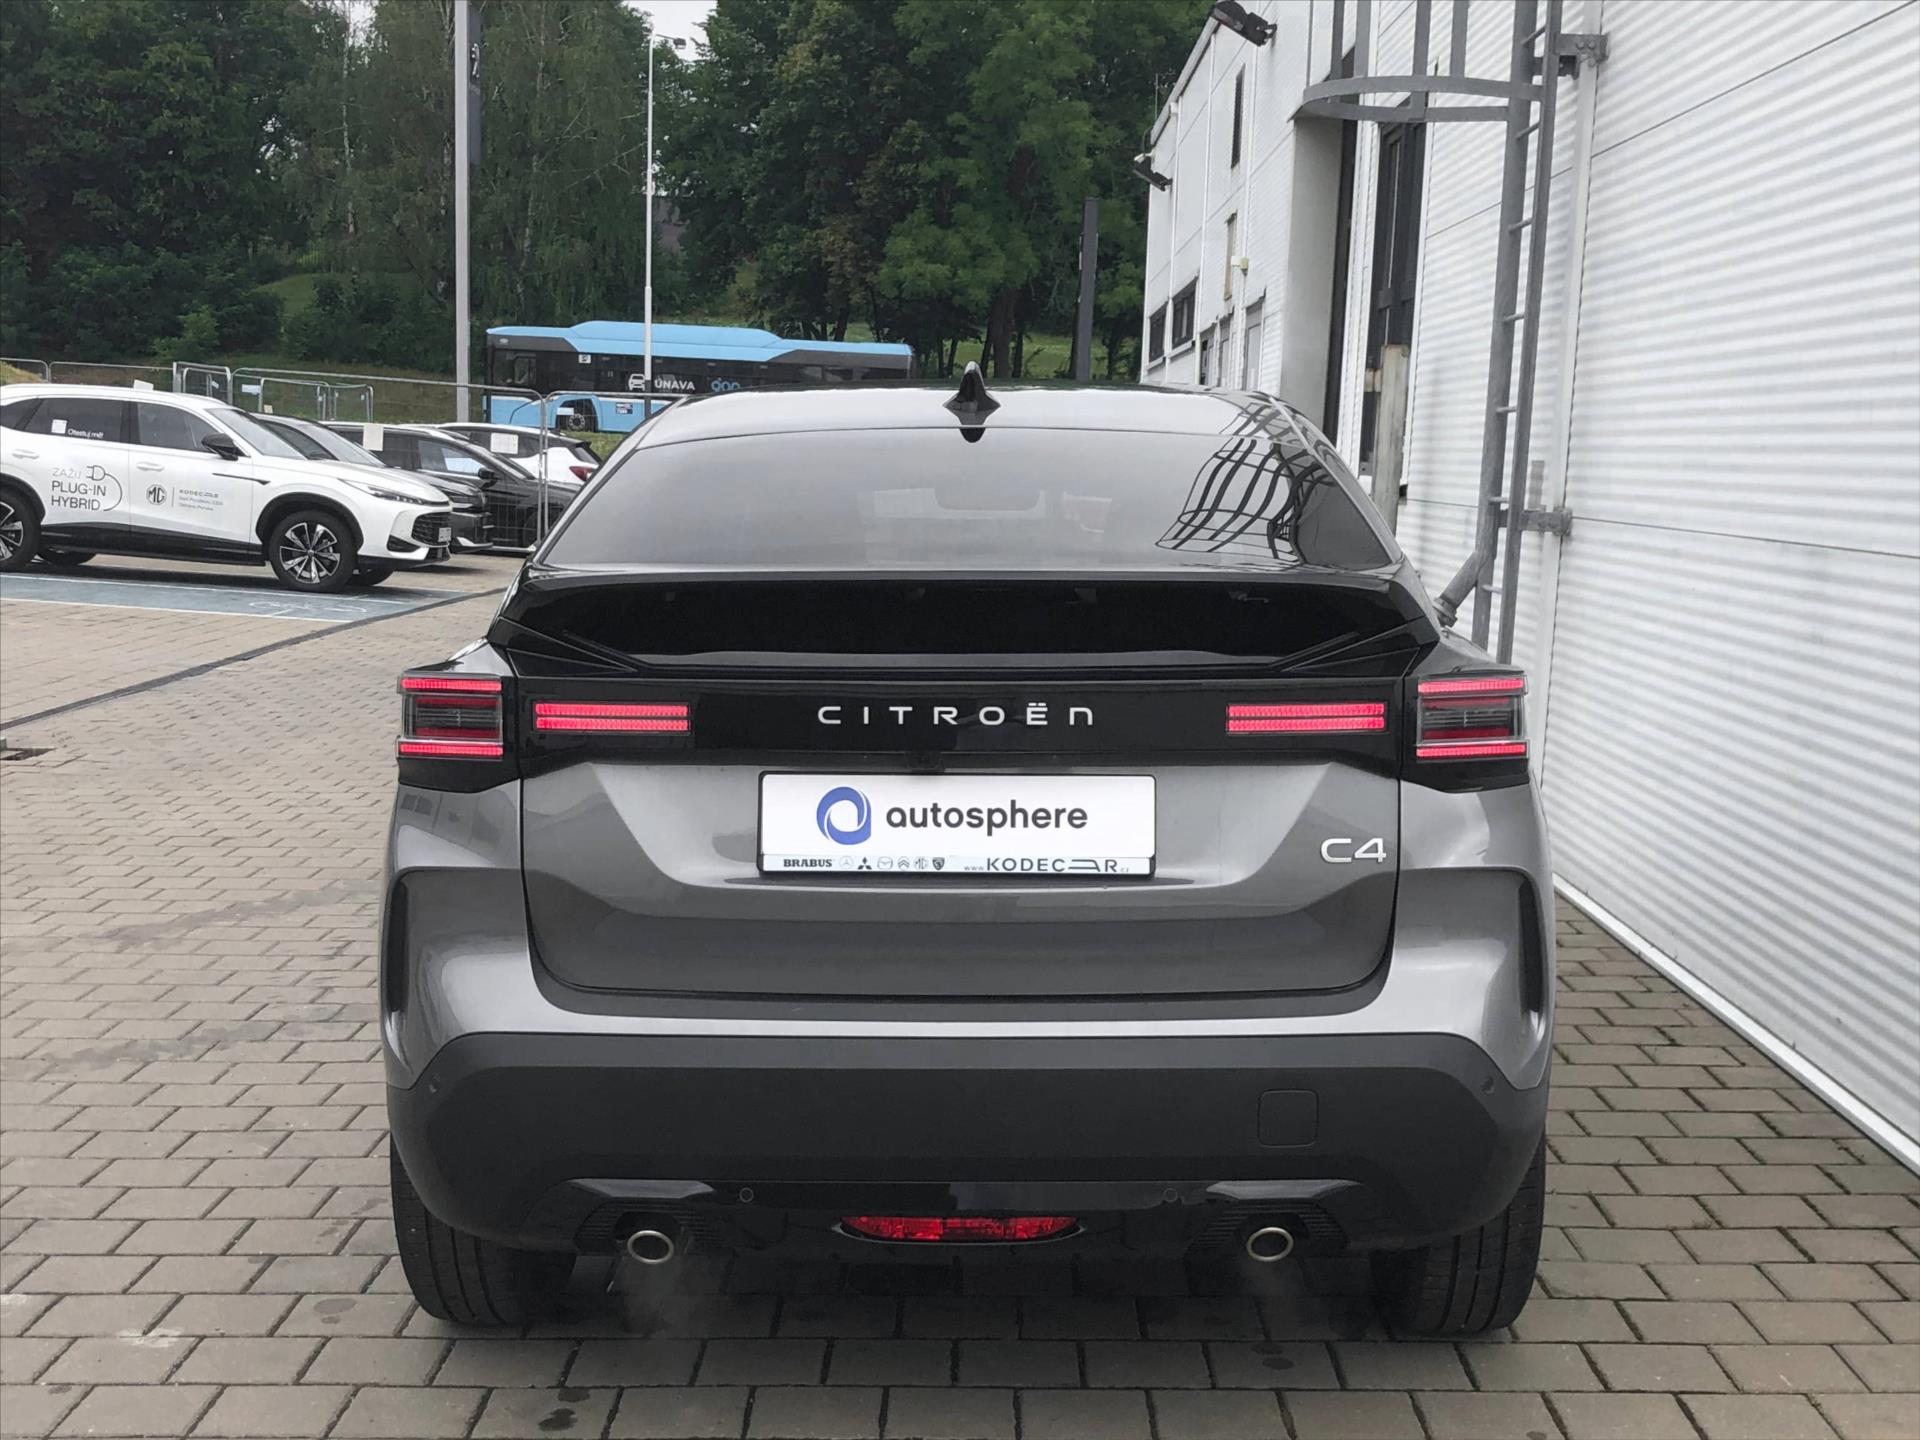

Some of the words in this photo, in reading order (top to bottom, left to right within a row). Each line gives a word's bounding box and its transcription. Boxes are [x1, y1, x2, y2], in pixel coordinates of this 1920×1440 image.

[51, 480, 107, 497] PLUG-IN
[148, 485, 166, 504] MG
[51, 495, 101, 512] HYBRID
[886, 800, 1088, 836] autosphere
[1321, 838, 1387, 863] C4
[783, 858, 833, 868] BRABUS
